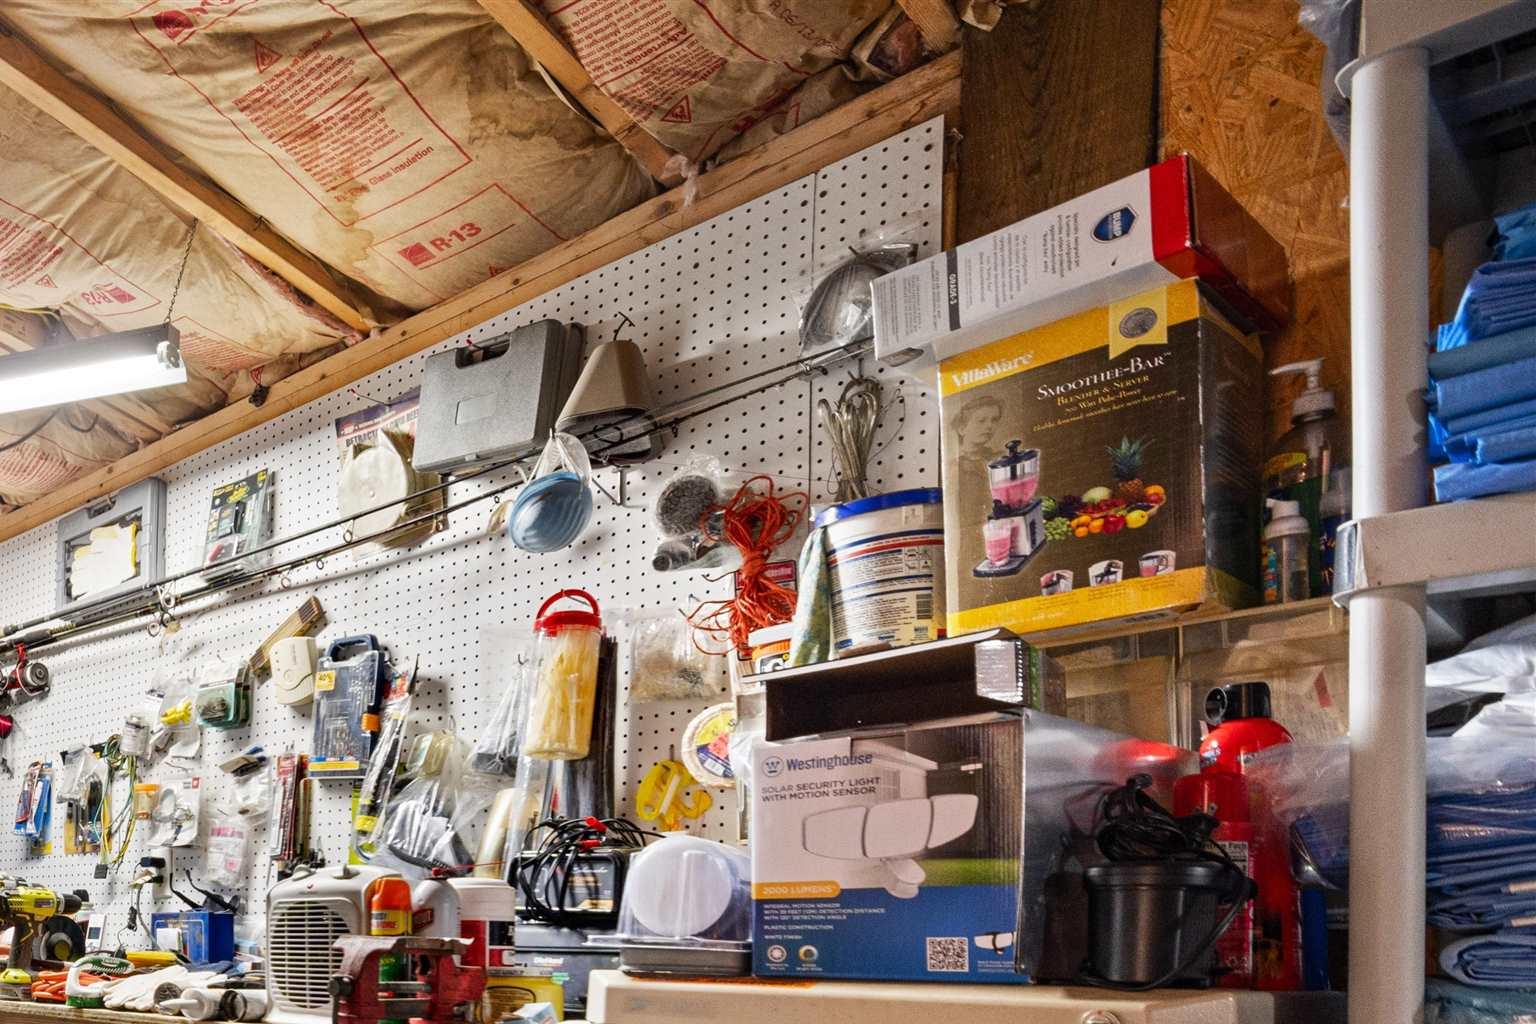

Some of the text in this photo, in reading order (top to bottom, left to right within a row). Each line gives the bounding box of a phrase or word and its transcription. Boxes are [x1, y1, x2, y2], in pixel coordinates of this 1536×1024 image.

[388, 144, 437, 174] Insulation
[430, 222, 482, 252] R-13
[951, 351, 1034, 387] VillaWare
[1113, 375, 1150, 388] SERVER
[786, 753, 873, 771] Westinghouse
[762, 776, 881, 795] SOLAR SECURITY LIGHT
[762, 785, 877, 802] WITH MOTION SENSOR
